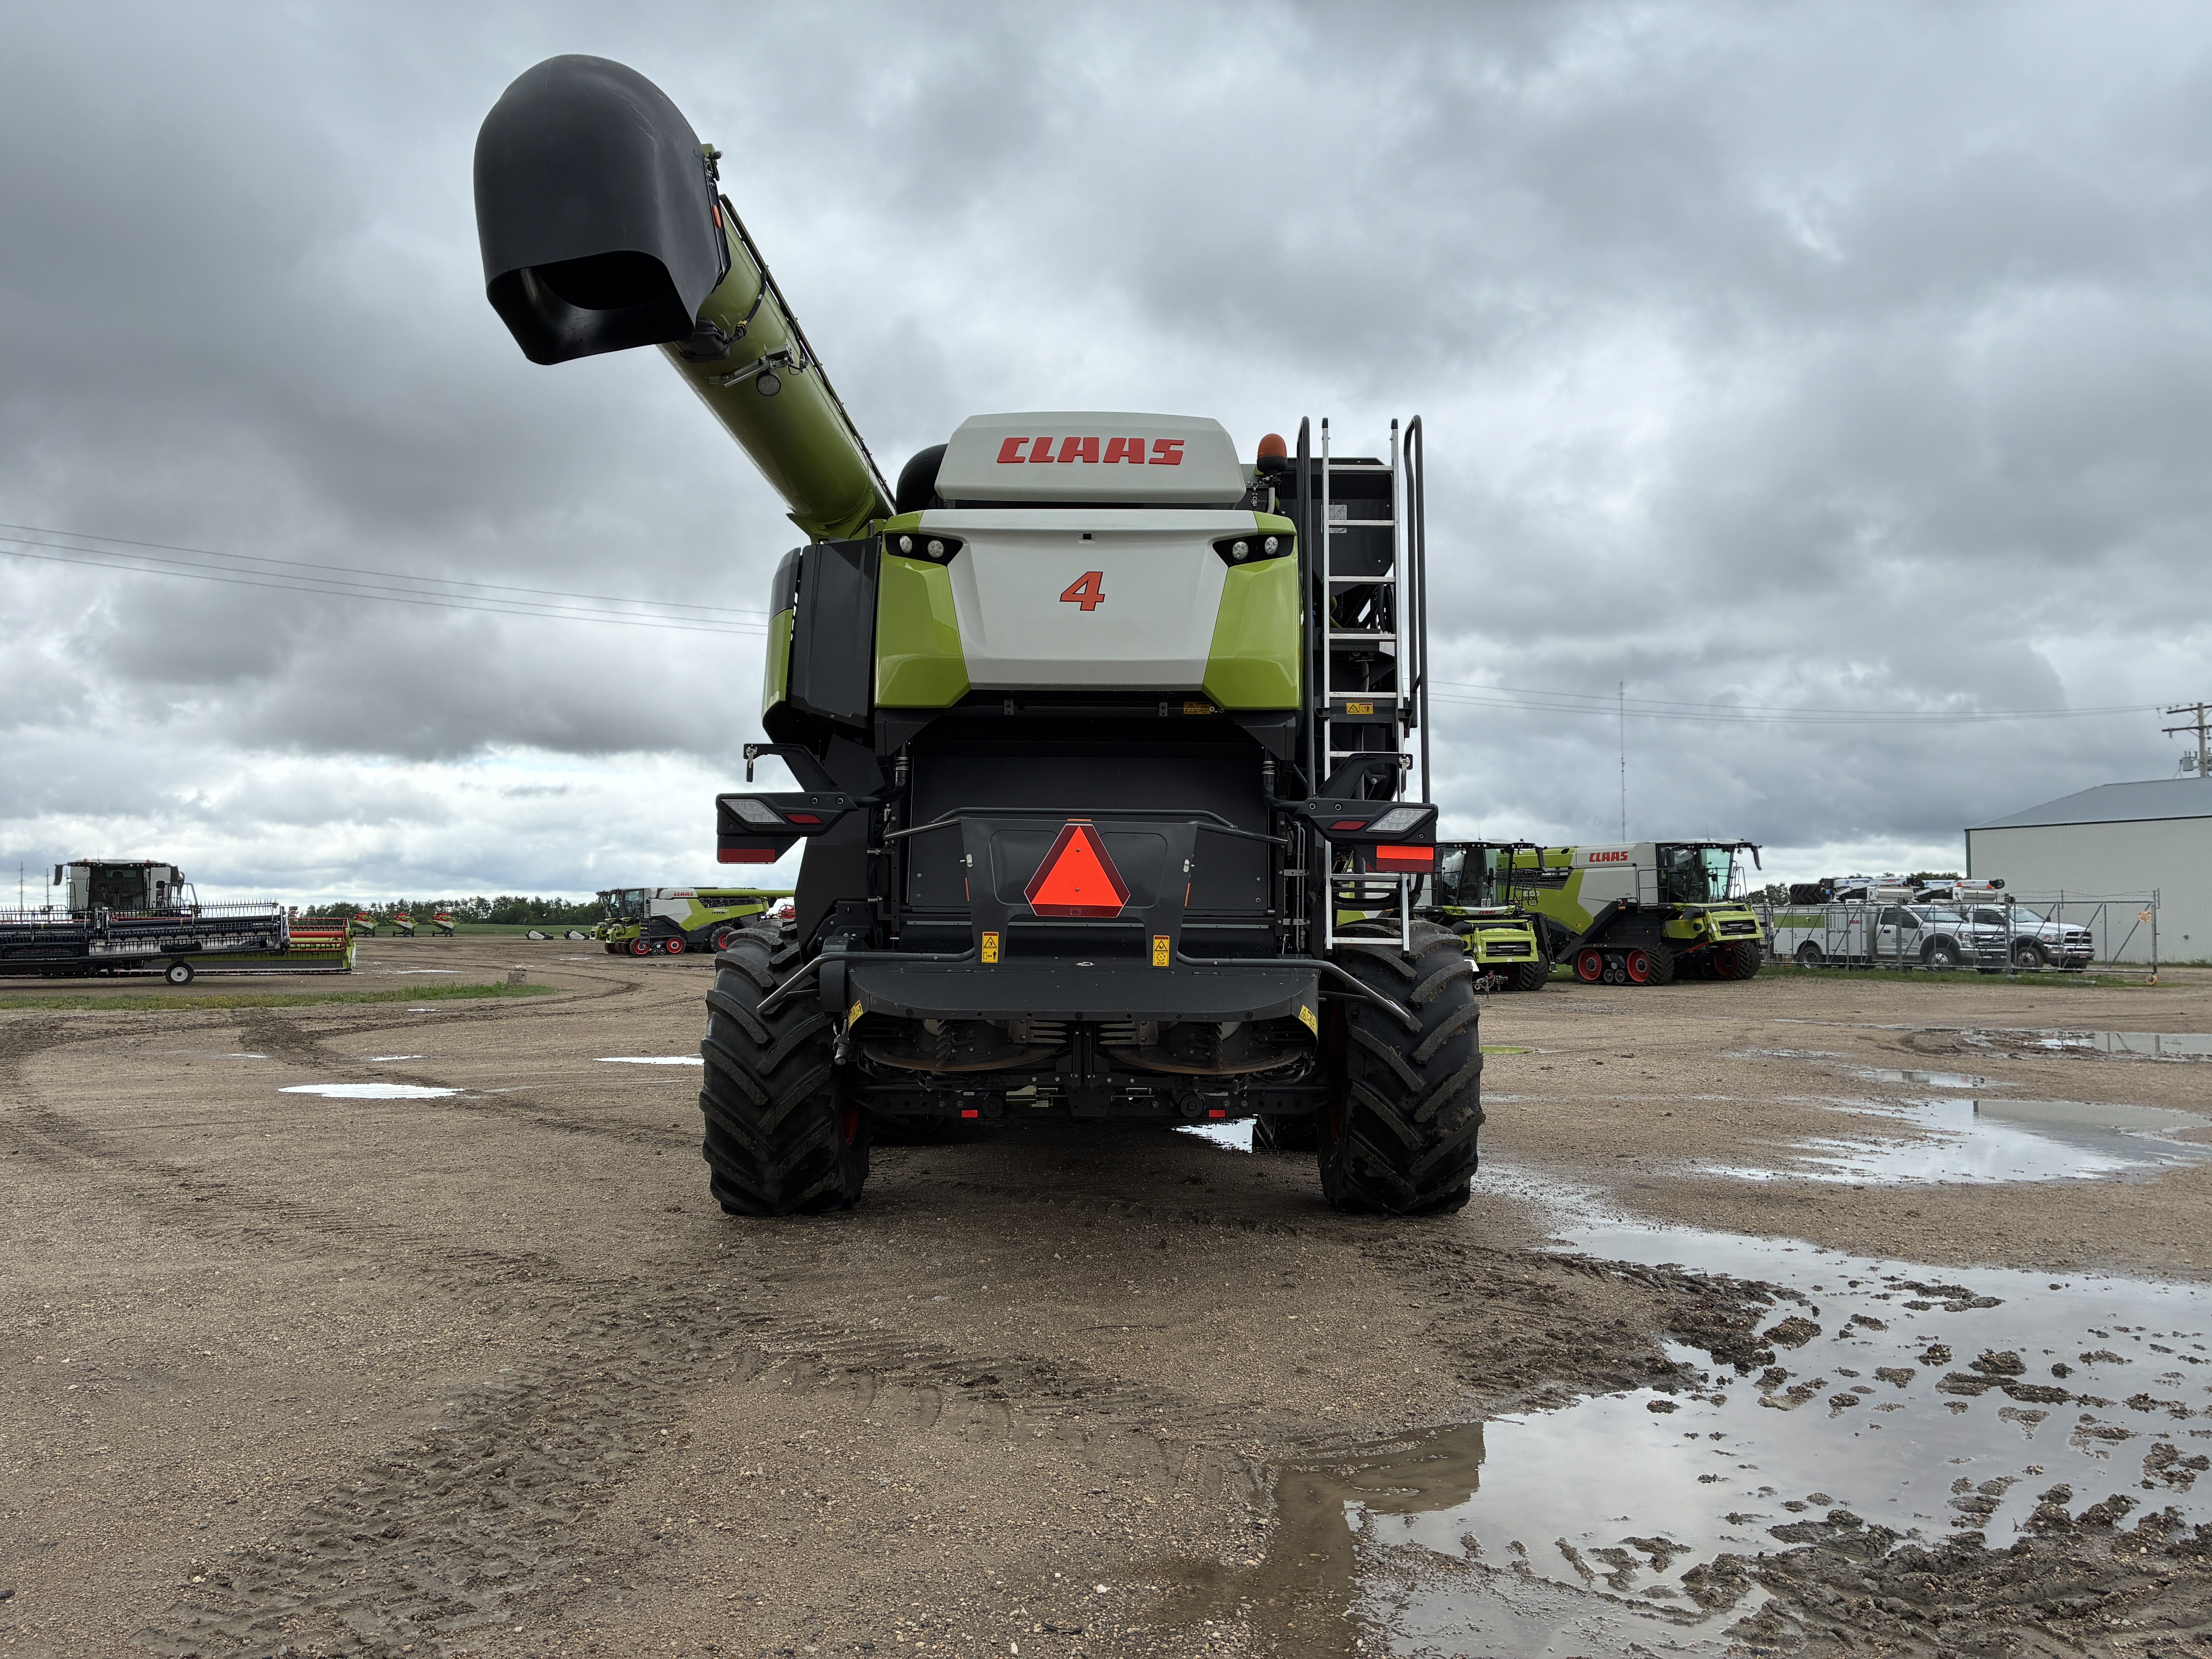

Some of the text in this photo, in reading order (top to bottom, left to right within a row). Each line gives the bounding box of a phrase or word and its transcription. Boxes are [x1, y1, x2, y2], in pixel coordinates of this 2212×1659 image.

[996, 436, 1185, 465] CLAAS
[1059, 571, 1105, 611] 4
[1589, 851, 1628, 862] CLAAS
